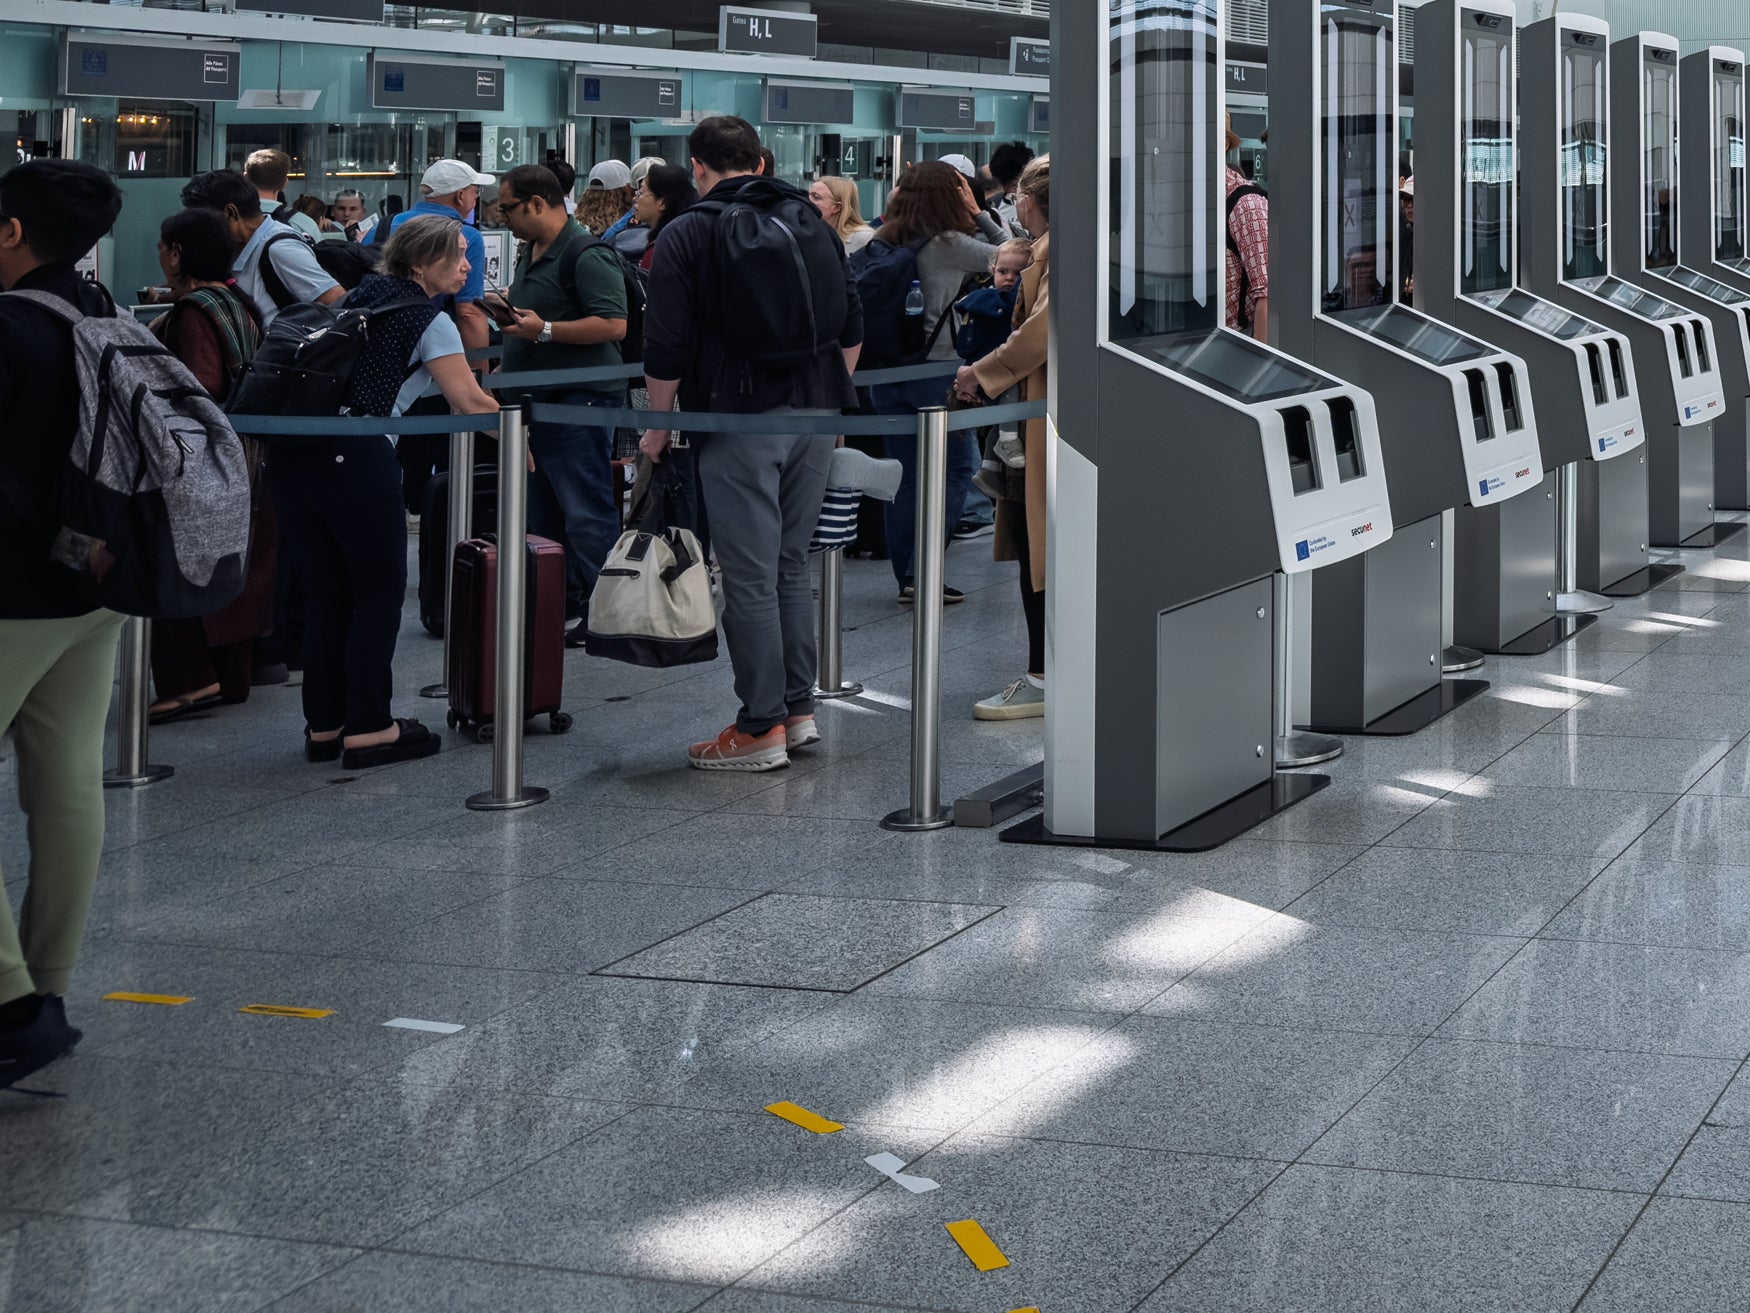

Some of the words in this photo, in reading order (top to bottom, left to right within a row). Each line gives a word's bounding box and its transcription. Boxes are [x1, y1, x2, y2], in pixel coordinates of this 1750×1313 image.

[732, 15, 747, 25] Gates
[501, 137, 515, 163] 3
[844, 145, 855, 166] 4
[1255, 154, 1261, 170] 6
